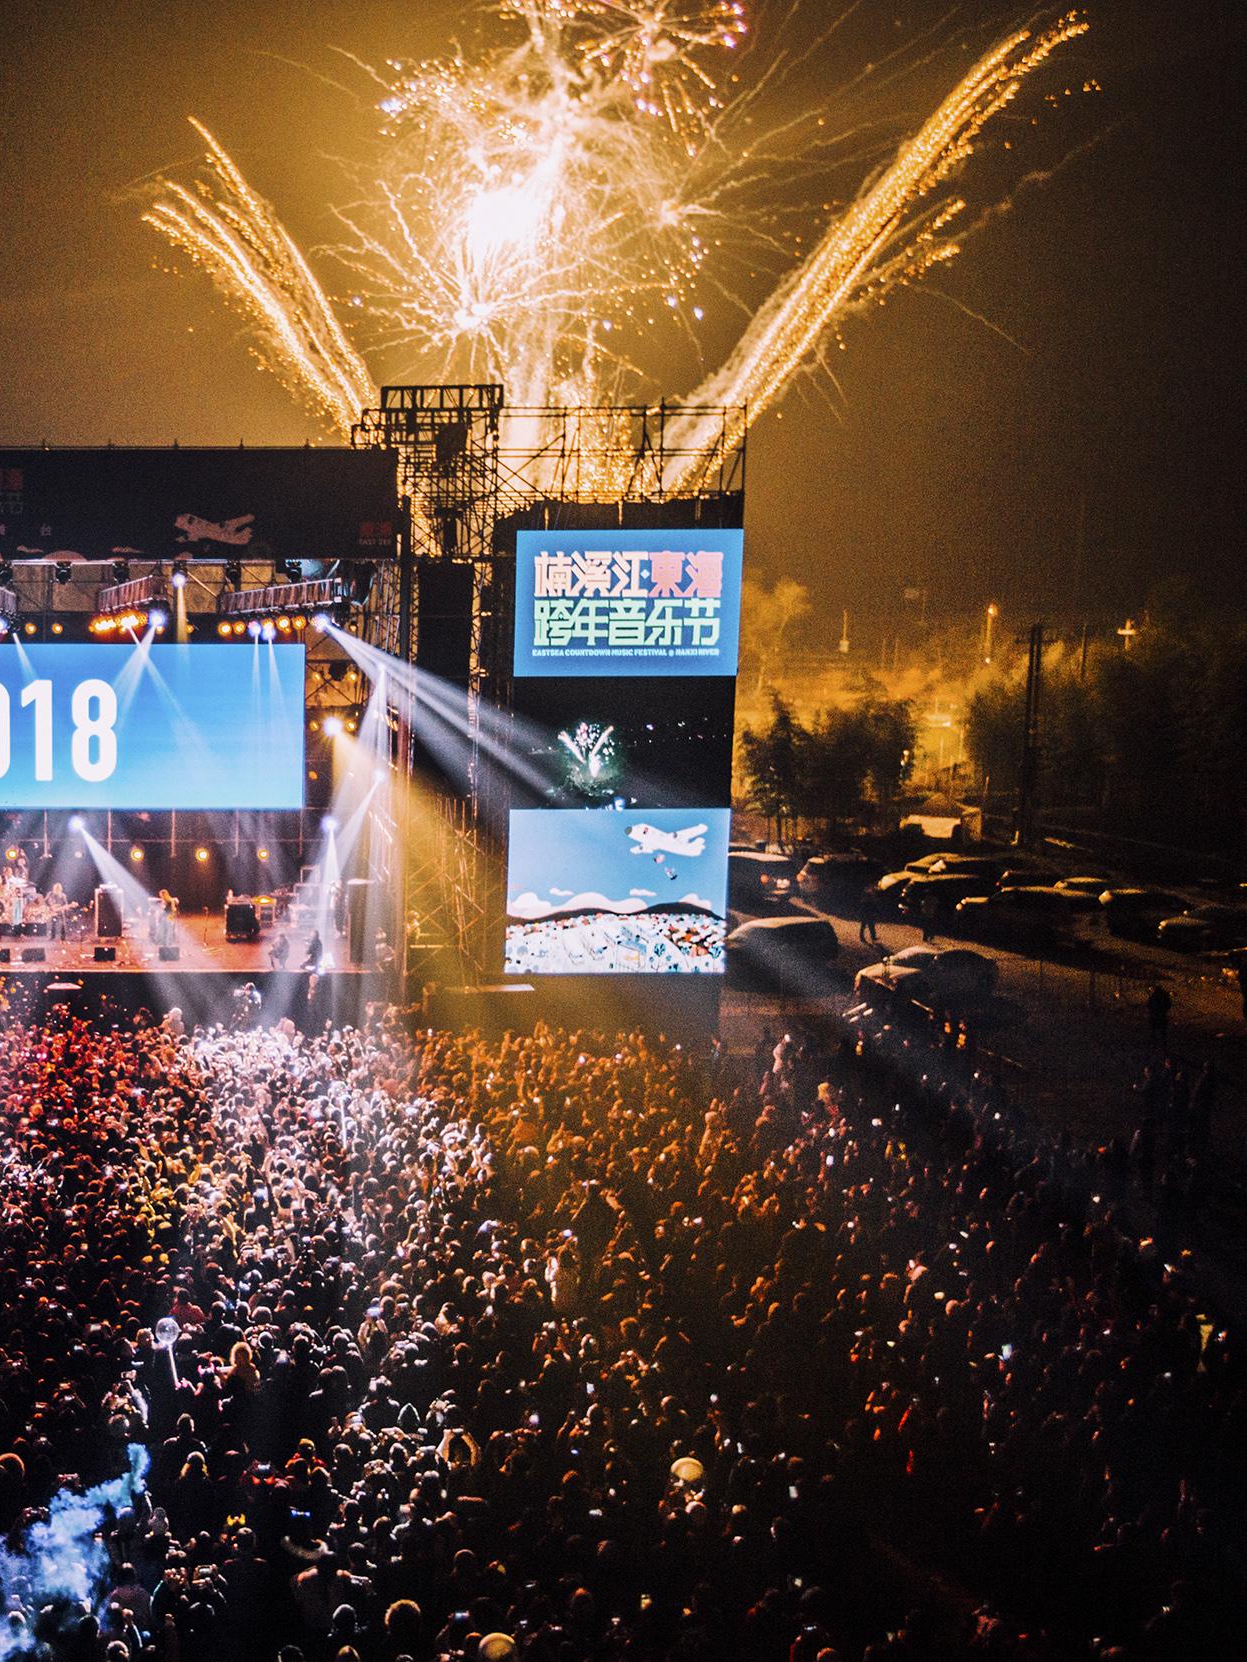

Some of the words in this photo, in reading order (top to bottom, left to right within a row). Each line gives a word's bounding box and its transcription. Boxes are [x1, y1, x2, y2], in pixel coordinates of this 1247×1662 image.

[534, 598, 721, 646] 跨年音乐节
[634, 648, 667, 656] FESTIVAL
